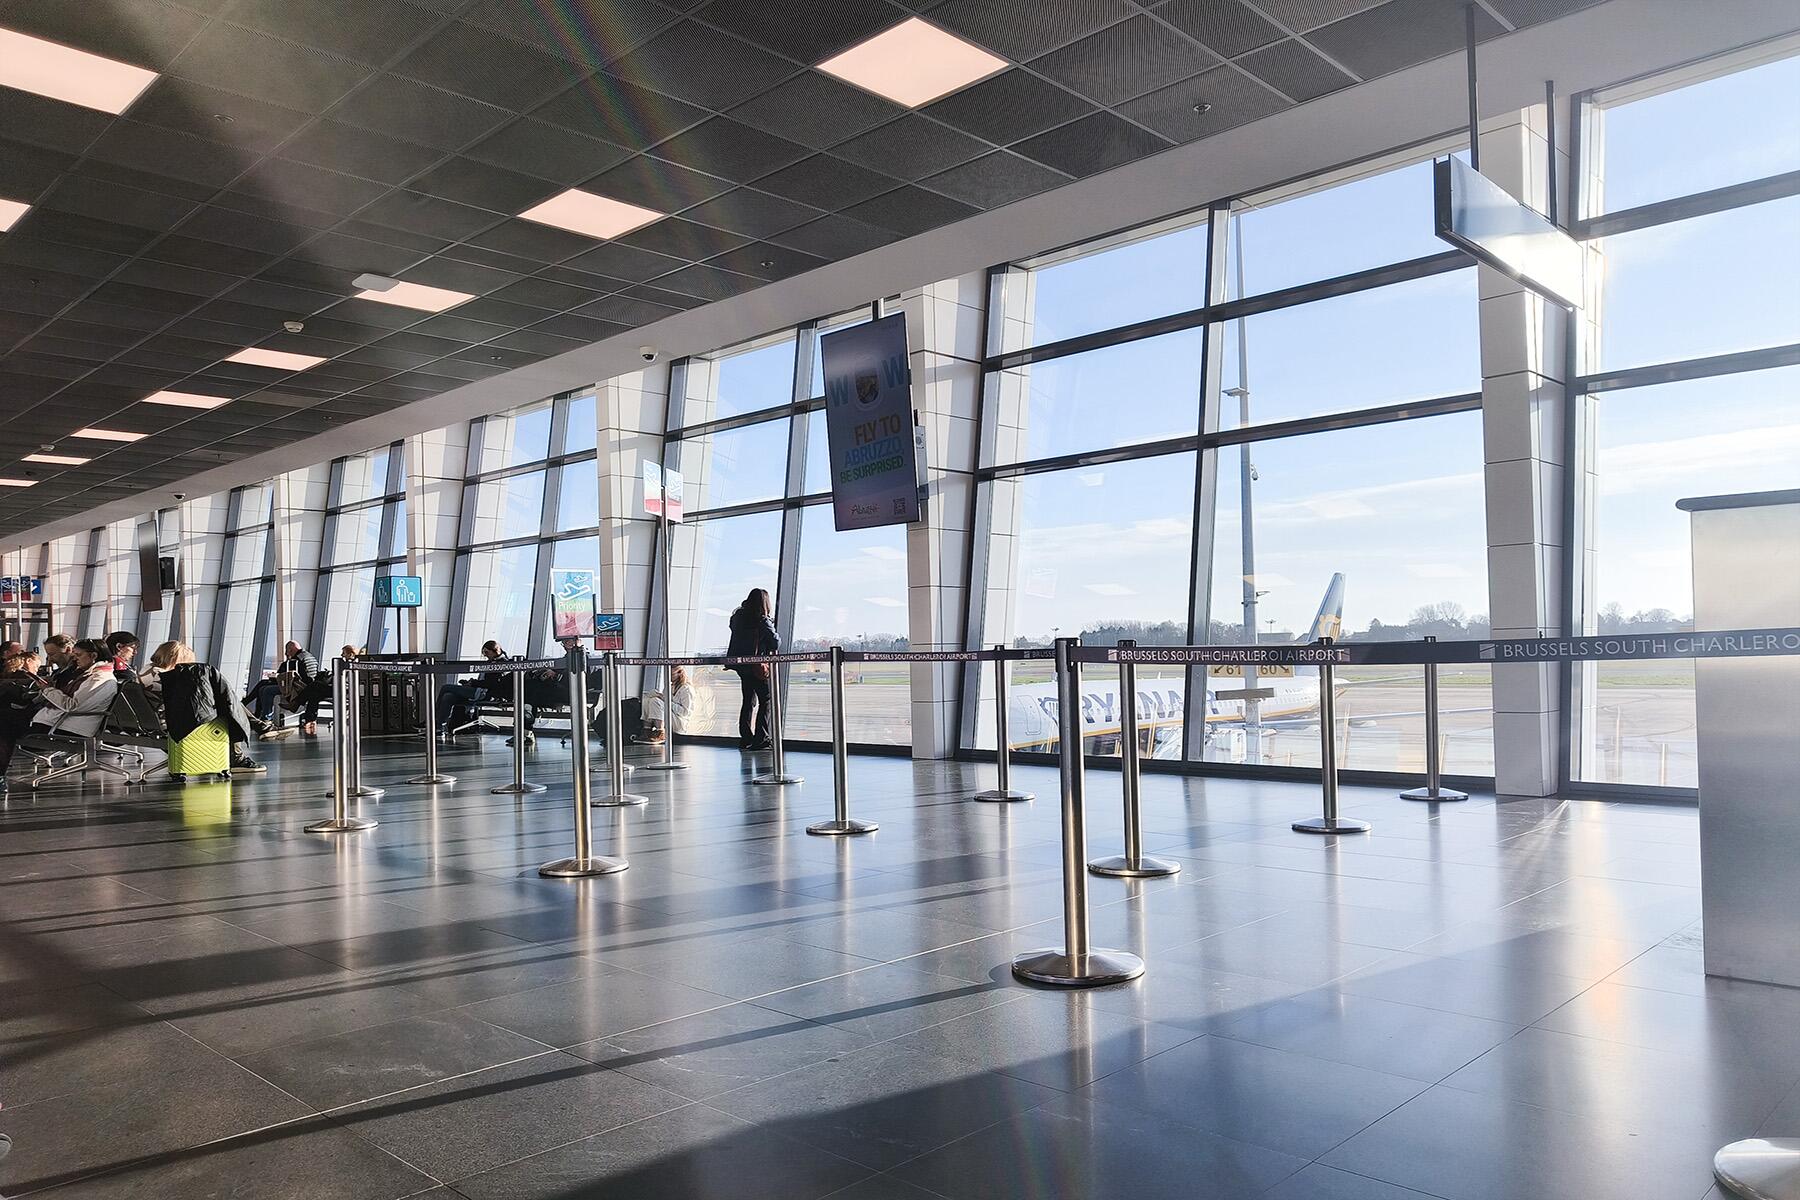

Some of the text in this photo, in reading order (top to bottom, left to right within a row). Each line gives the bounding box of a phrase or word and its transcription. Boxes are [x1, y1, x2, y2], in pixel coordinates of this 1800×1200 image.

[854, 414, 901, 446] FLY TO
[840, 469, 853, 484] BE
[559, 601, 586, 612] Priority
[1504, 641, 1588, 658] BRUSSELS
[1594, 639, 1666, 655] SOUTH
[1032, 650, 1056, 659] BRUSSE
[1121, 649, 1345, 661] BRUSSELS SOUTH CHARLEROI AIRPORT
[1226, 664, 1241, 675] 61
[1260, 664, 1277, 675] 60
